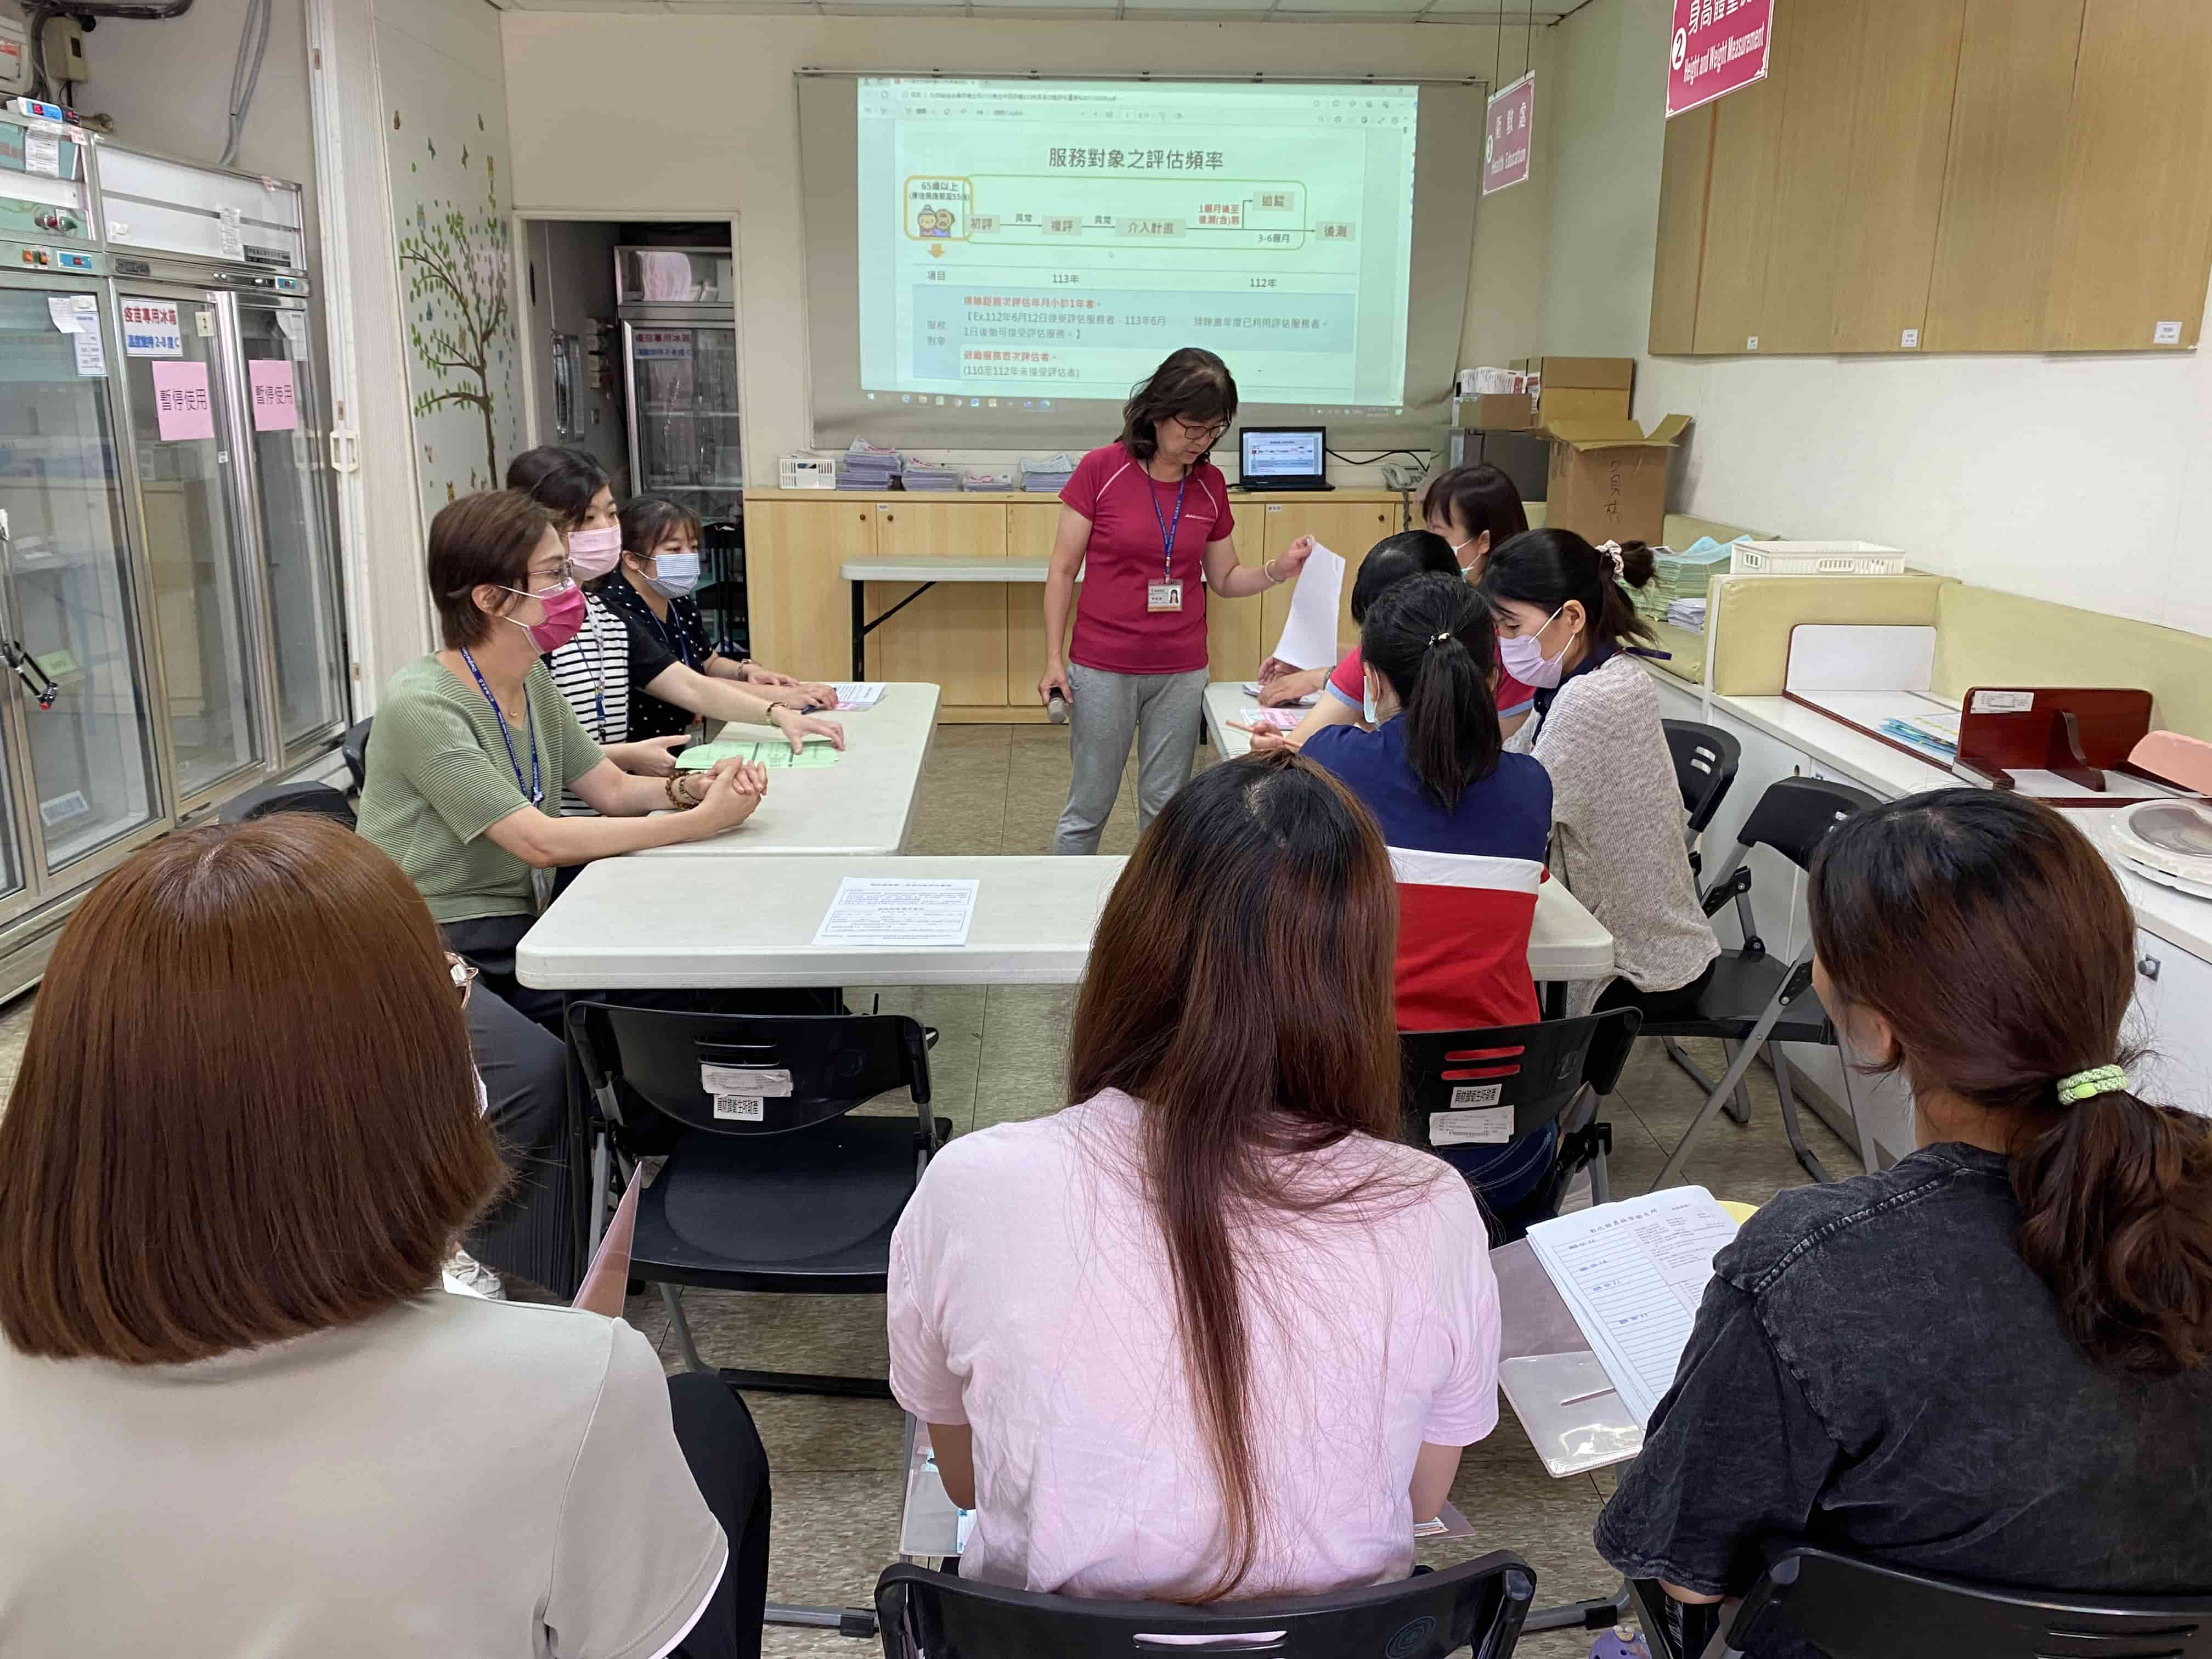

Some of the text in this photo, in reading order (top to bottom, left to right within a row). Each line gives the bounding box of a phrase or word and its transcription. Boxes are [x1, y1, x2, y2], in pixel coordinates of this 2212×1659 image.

[1683, 20, 1765, 86] Height and Weight Measurement
[1048, 147, 1223, 170] 服務對象之評估頻率
[970, 217, 992, 230] 初評
[927, 271, 946, 281] 項目
[1053, 274, 1079, 284] 113年
[1250, 278, 1277, 288] 112年
[160, 388, 208, 411] 暫停使用
[255, 385, 295, 405] 暫停使用
